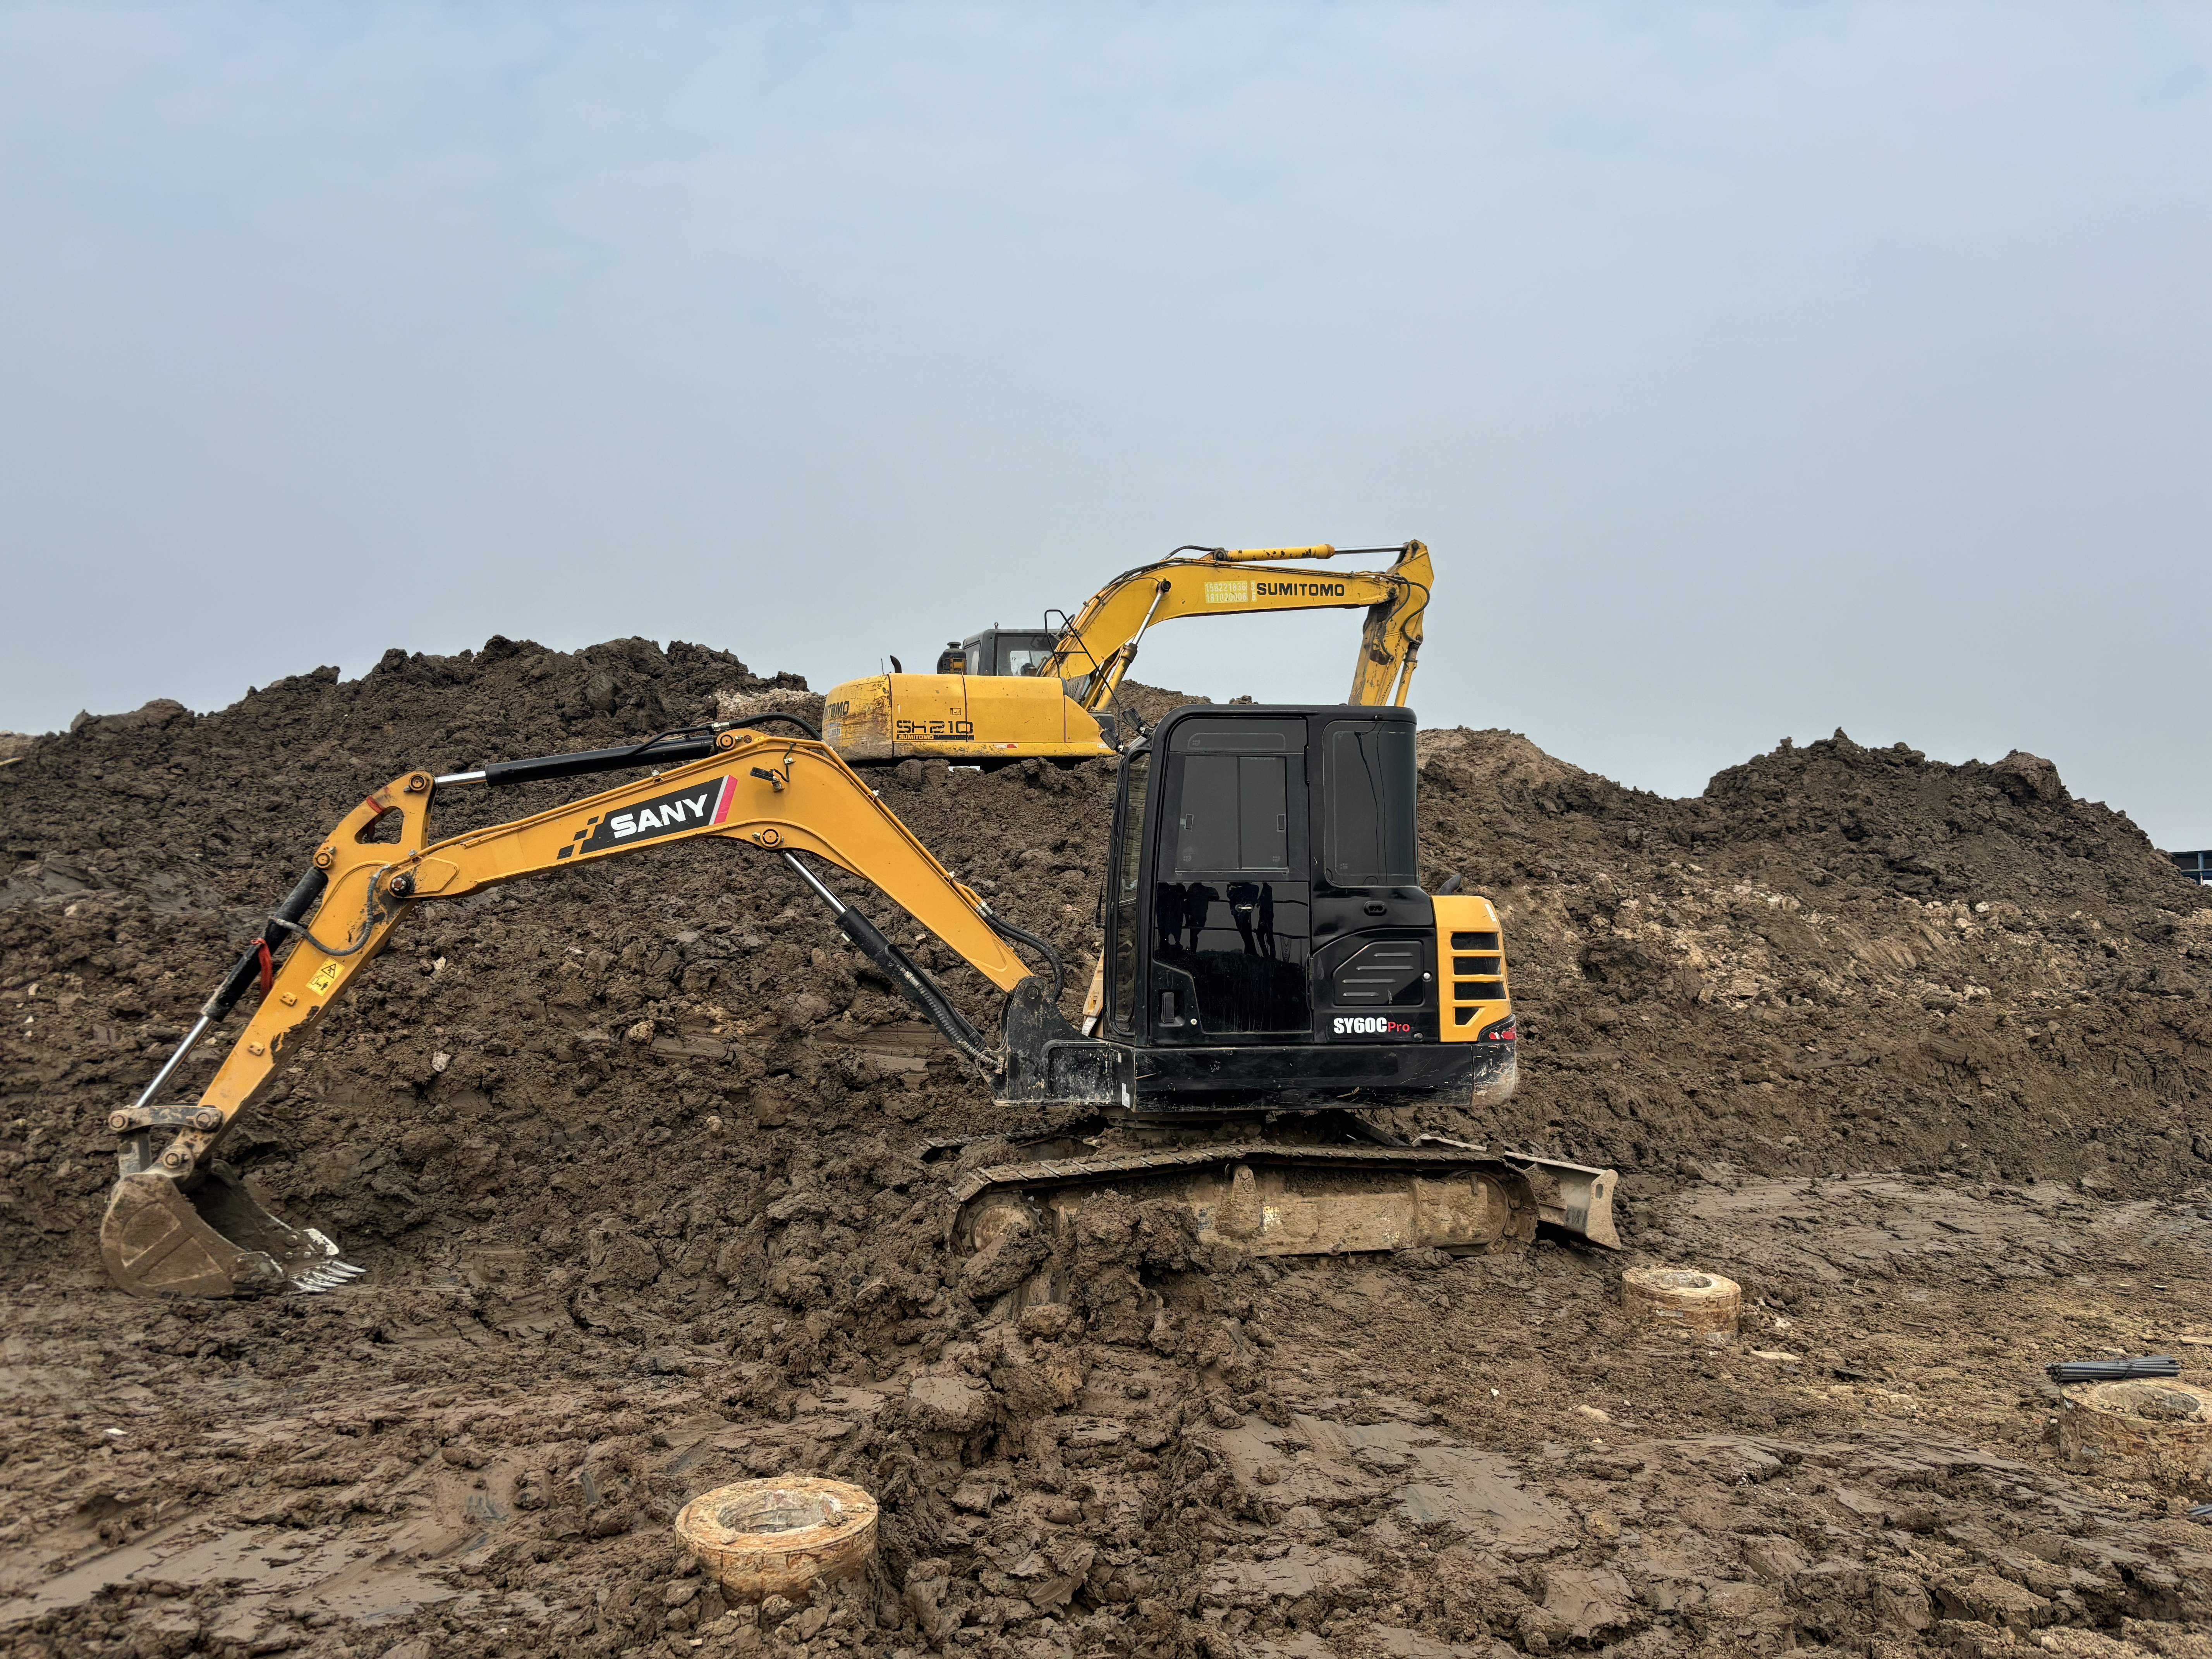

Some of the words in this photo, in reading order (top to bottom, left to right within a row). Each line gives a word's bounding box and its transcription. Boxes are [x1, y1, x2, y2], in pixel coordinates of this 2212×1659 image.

[1257, 582, 1345, 596] SUMITOMO
[896, 720, 973, 734] SH210
[610, 793, 708, 838] SANY
